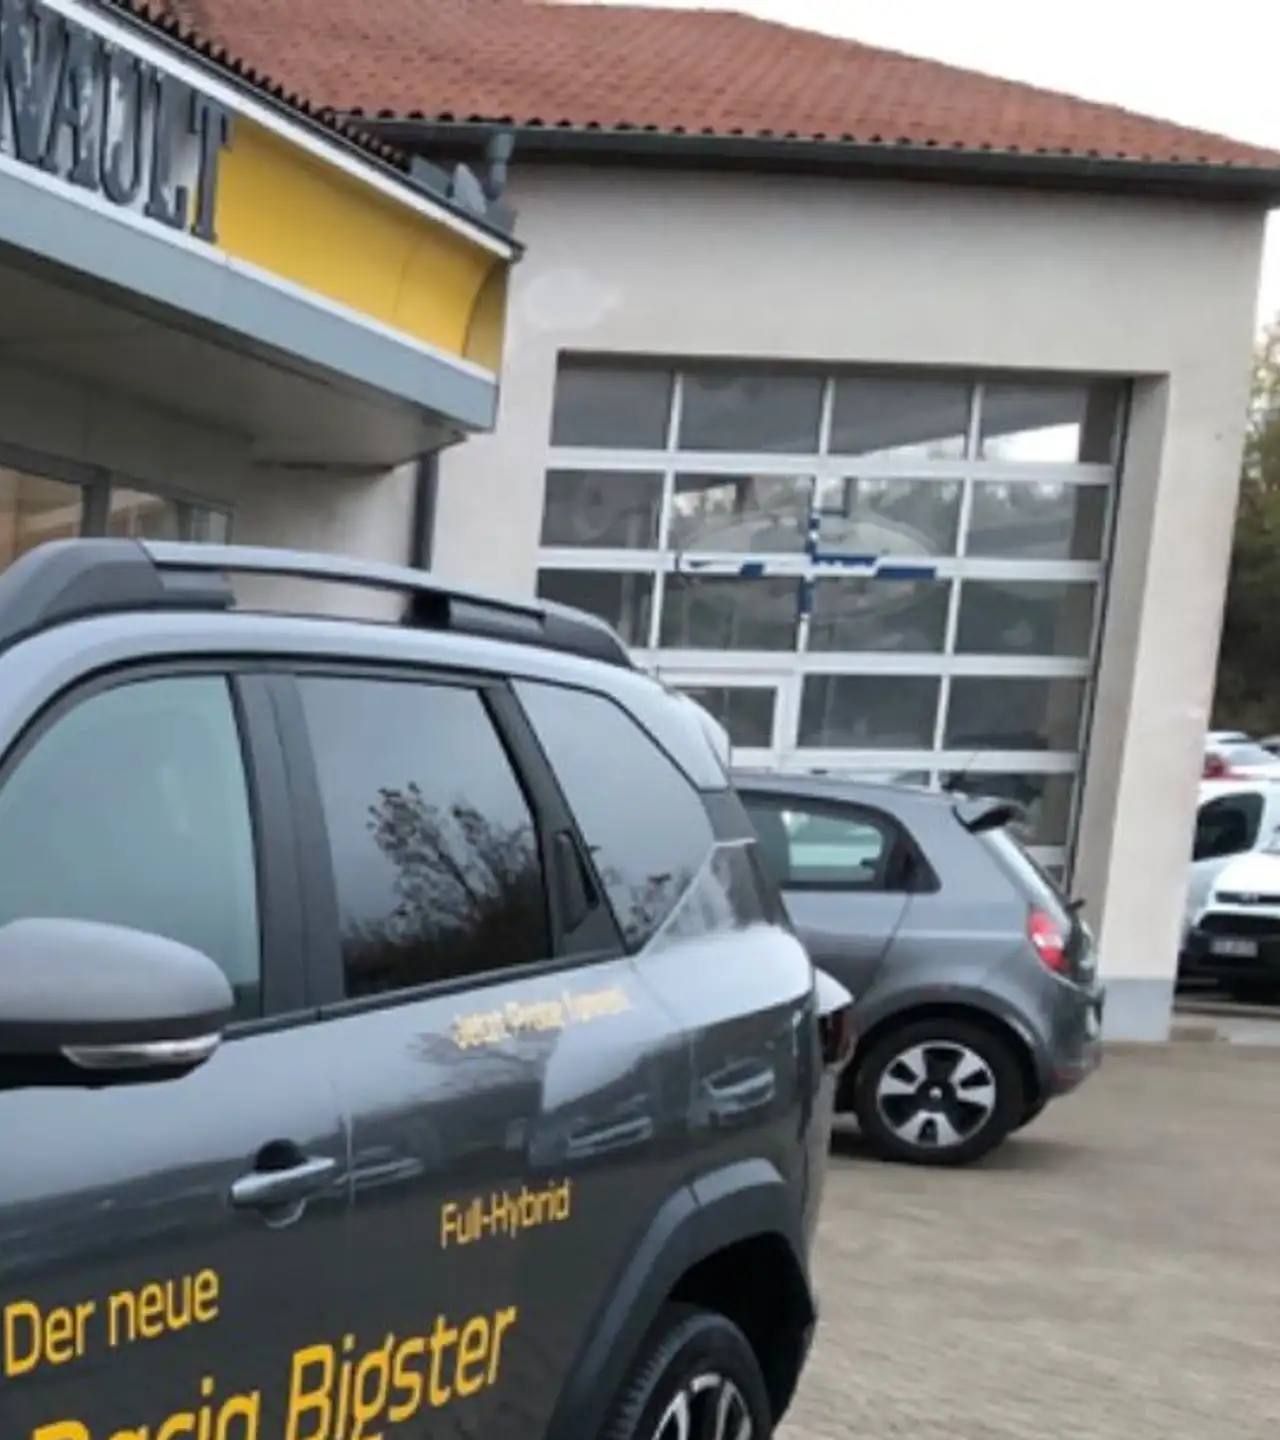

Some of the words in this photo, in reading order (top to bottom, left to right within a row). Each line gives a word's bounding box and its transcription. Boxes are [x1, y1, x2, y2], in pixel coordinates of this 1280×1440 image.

[441, 1176, 573, 1250] Full-Hybrid
[2, 1300, 96, 1378] Der
[108, 1268, 220, 1346] neue
